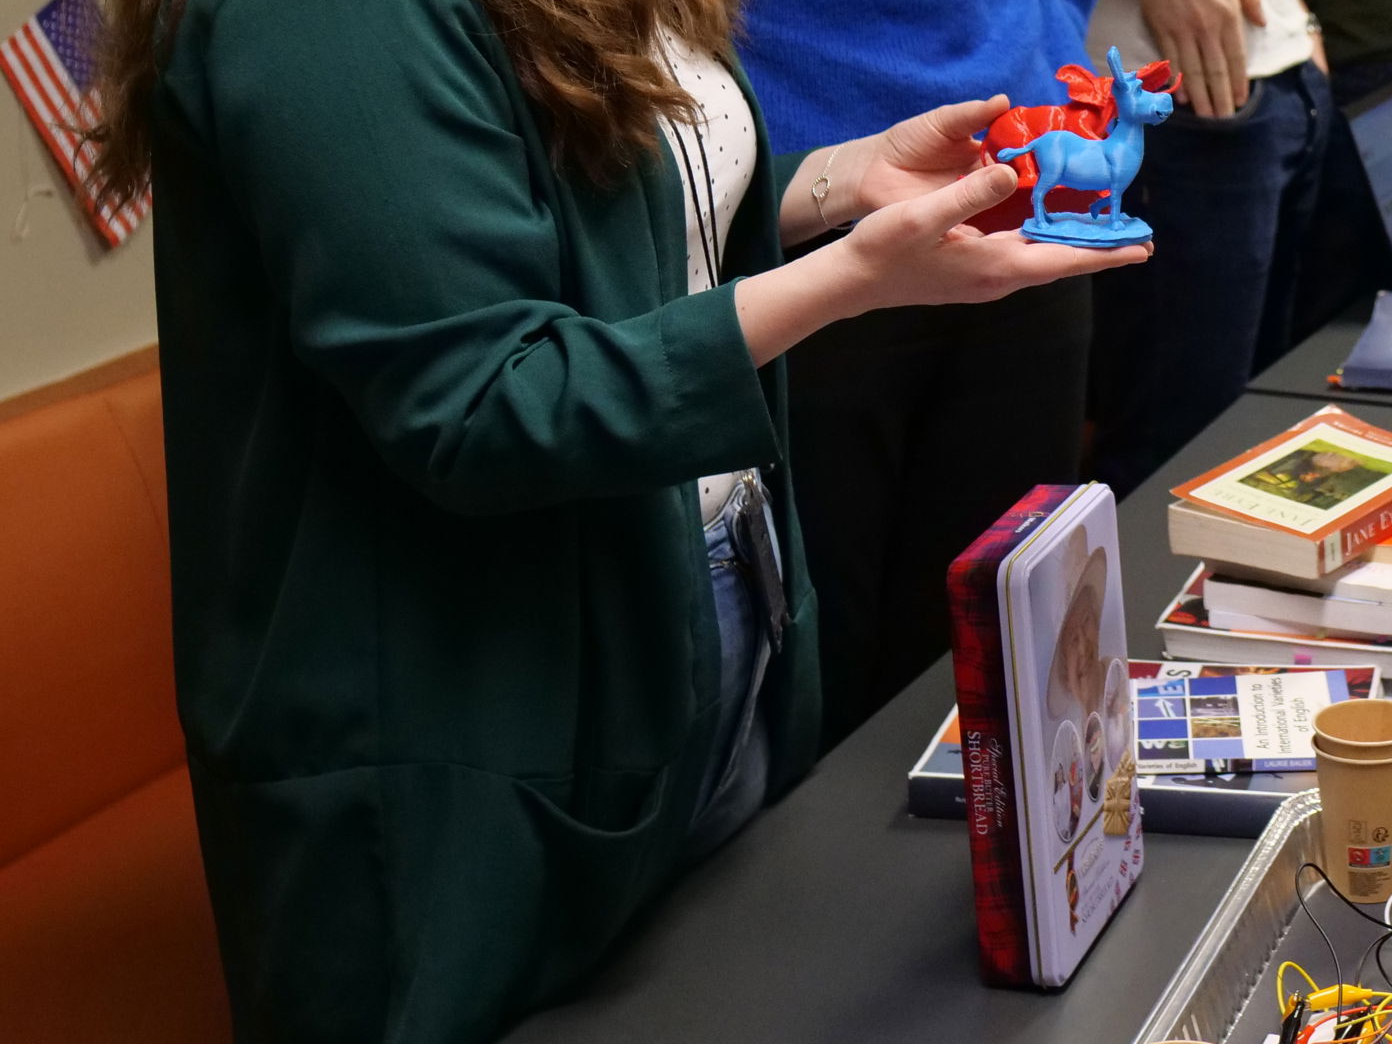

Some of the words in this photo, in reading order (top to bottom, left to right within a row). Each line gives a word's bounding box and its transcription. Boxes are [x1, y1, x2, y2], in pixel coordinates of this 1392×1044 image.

[1345, 522, 1376, 556] JANE
[1251, 683, 1263, 692] to
[1271, 677, 1285, 707] Varieties
[1252, 693, 1269, 736] Introduction
[1289, 697, 1311, 723] English
[1256, 738, 1270, 750] An
[1275, 709, 1293, 754] International
[1293, 725, 1309, 733] of
[982, 753, 992, 776] PURE
[986, 737, 1004, 787] Special
[1174, 762, 1198, 770] English
[967, 730, 989, 836] SHORTBREAD
[984, 778, 994, 813] BUTTER
[993, 784, 1008, 828] Edition
